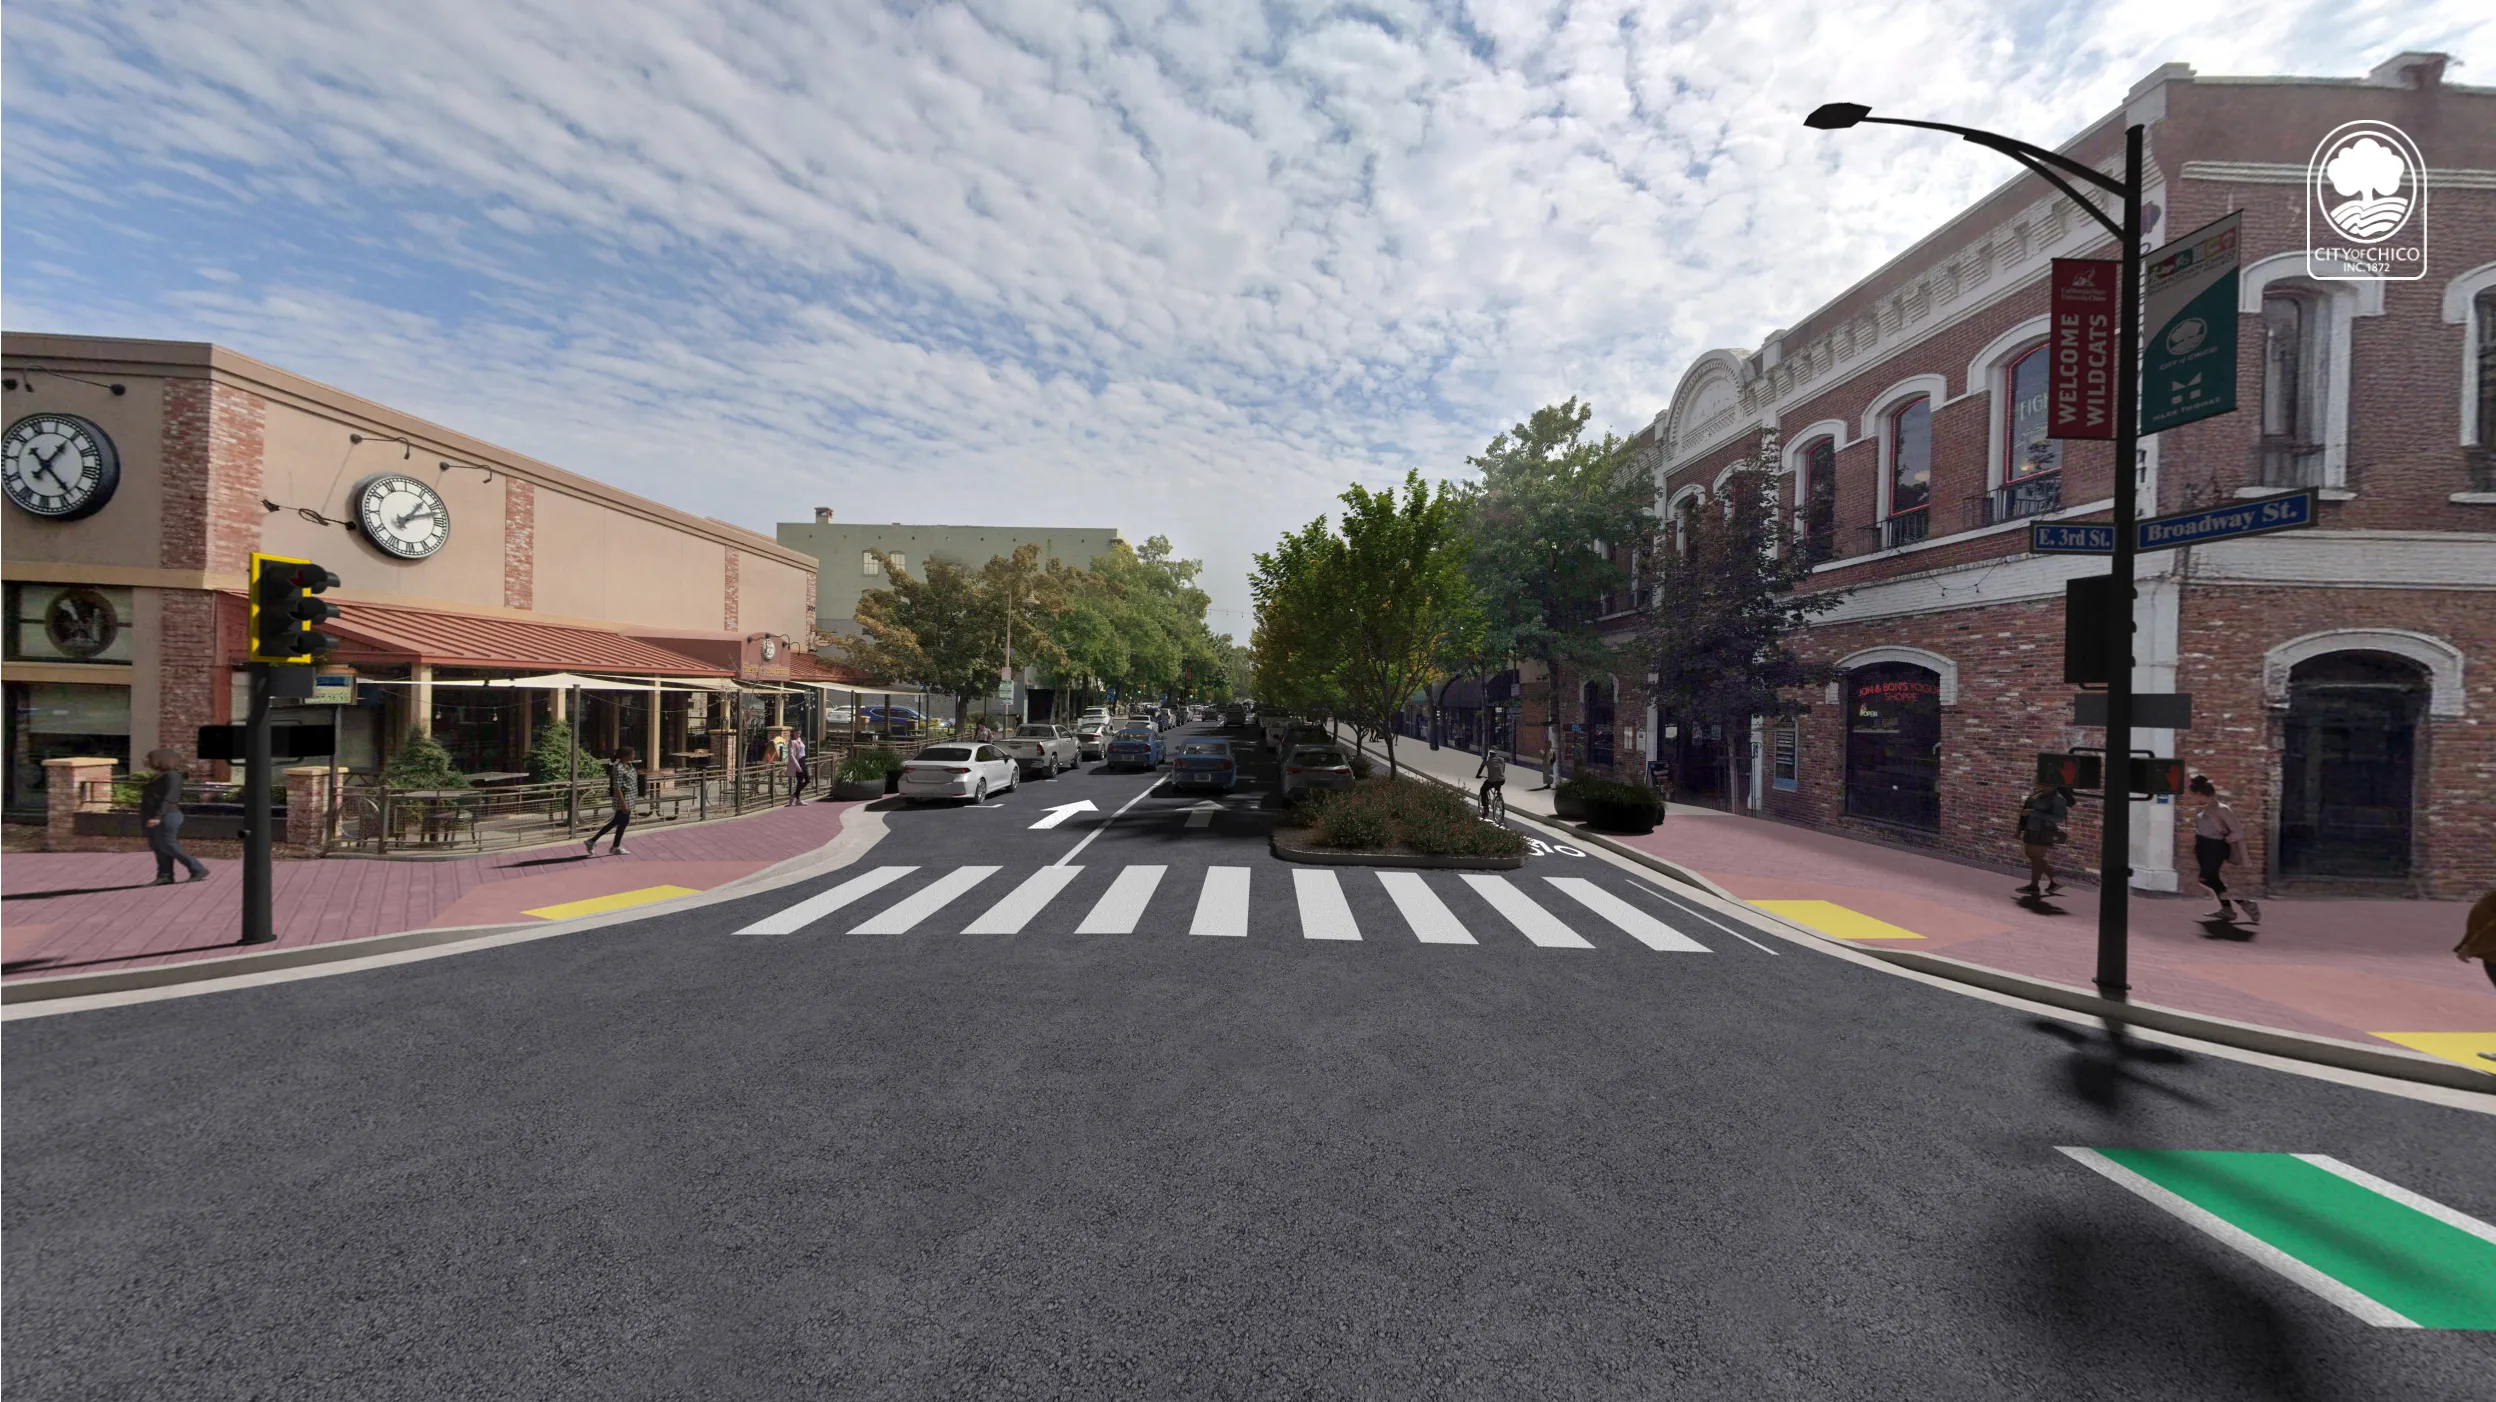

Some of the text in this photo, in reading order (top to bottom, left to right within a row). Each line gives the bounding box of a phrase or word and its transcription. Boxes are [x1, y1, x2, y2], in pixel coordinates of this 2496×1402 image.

[2058, 313, 2080, 425] WELCOME
[2086, 314, 2108, 427] WILDCATS
[2038, 526, 2112, 548] E. 3rd St.
[2147, 500, 2299, 544] Broadway St.
